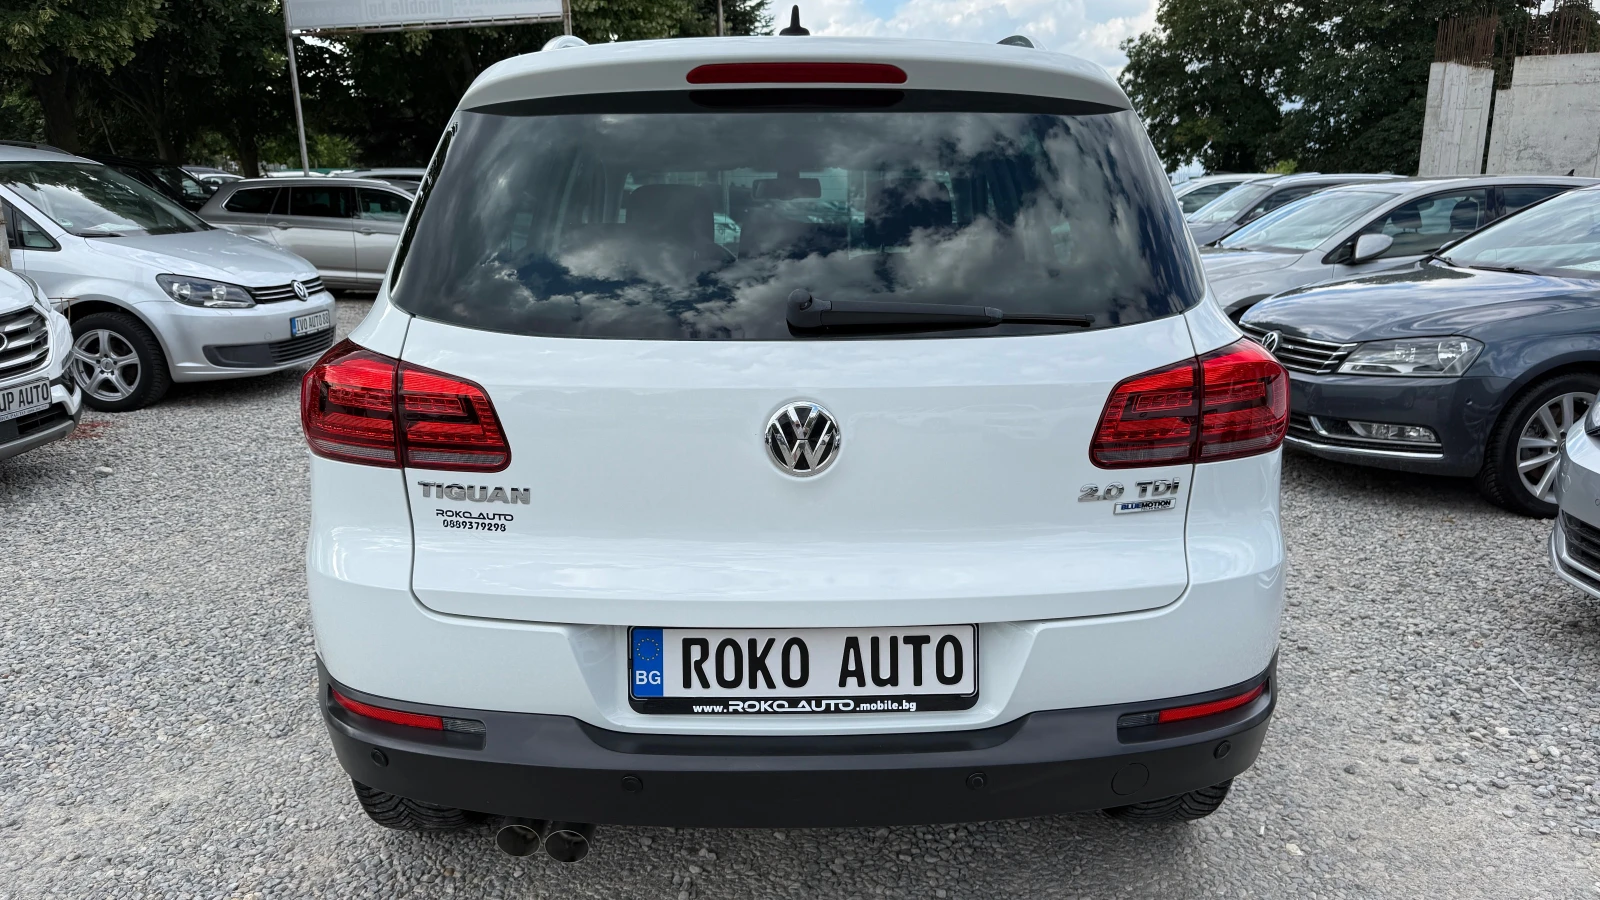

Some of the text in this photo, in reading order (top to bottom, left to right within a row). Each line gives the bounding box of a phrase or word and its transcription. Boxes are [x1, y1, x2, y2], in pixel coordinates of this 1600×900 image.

[309, 314, 323, 329] AUTO
[19, 382, 50, 408] AUTO
[417, 480, 531, 505] TIGUAN
[1078, 477, 1180, 502] 2.0 TDI
[1121, 499, 1171, 510] BLUEMOTION
[443, 519, 507, 532] 0889379298
[681, 634, 964, 689] ROKO AUTO
[635, 670, 661, 685] BG
